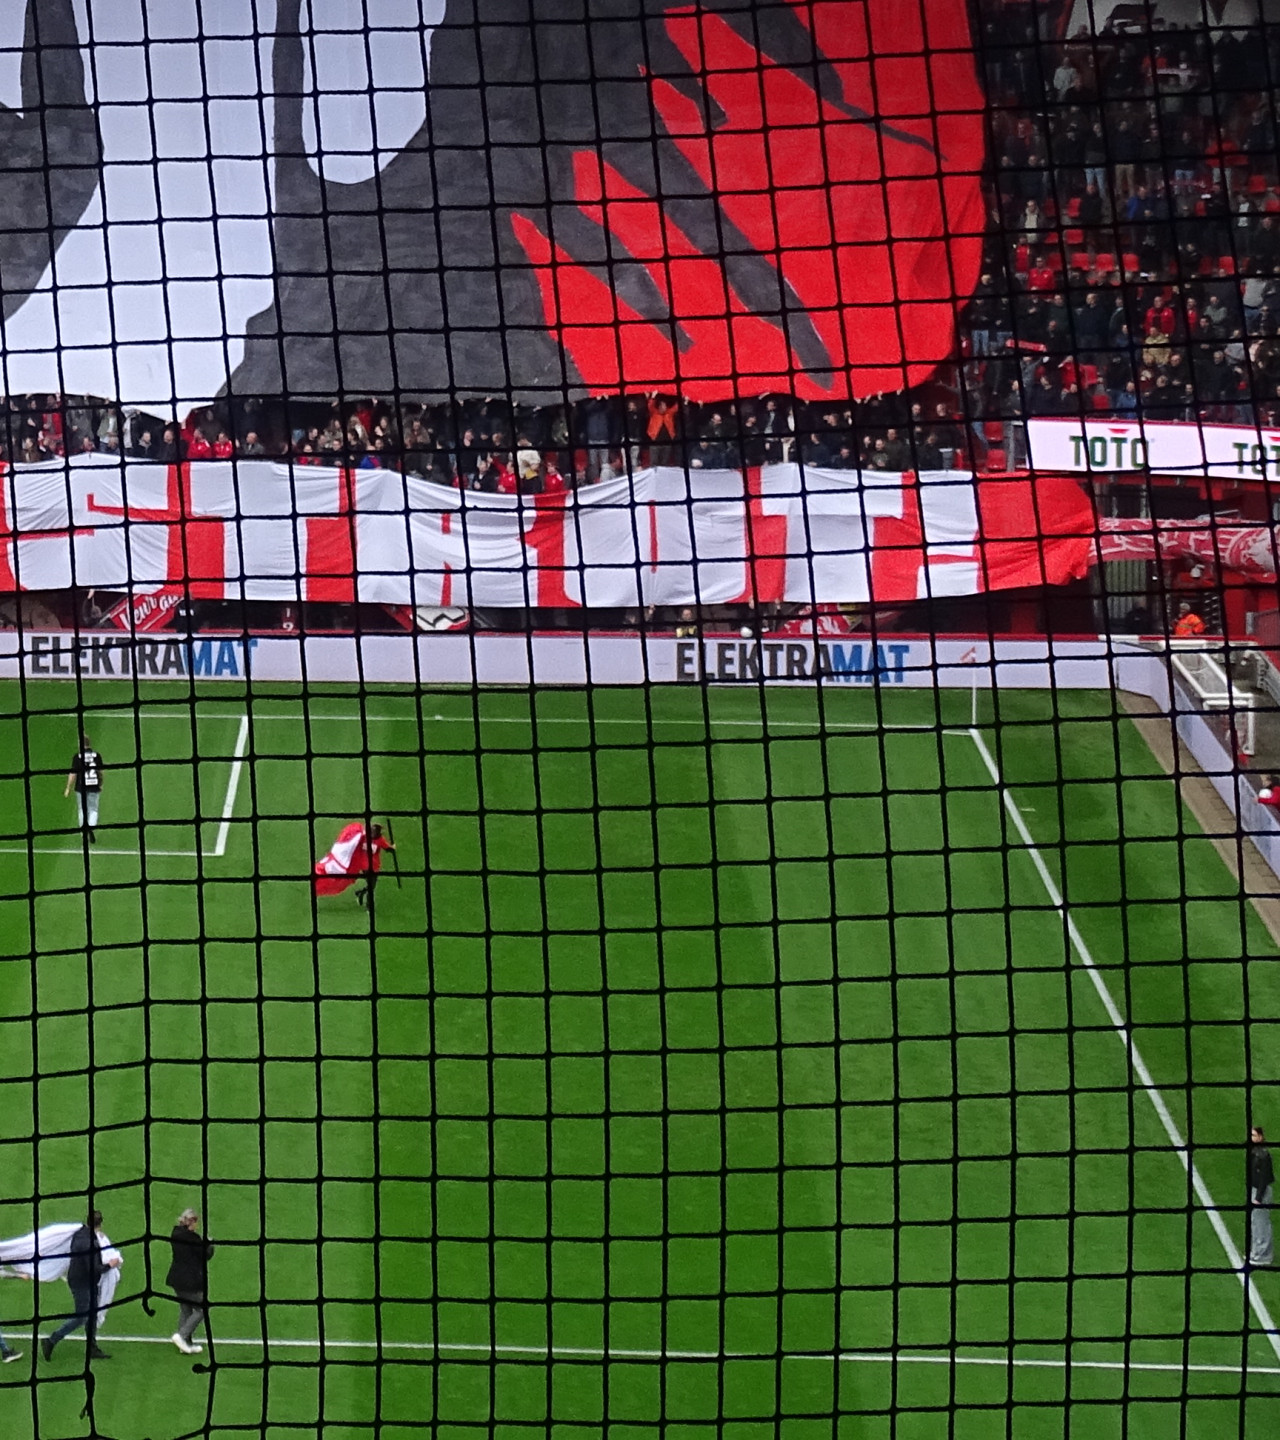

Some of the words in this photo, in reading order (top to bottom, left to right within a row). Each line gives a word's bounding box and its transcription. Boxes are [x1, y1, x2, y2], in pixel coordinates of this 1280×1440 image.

[1070, 435, 1149, 468] TOTO
[31, 636, 258, 676] ELEKTRAMAT
[677, 642, 910, 683] ELEKTRAMAT
